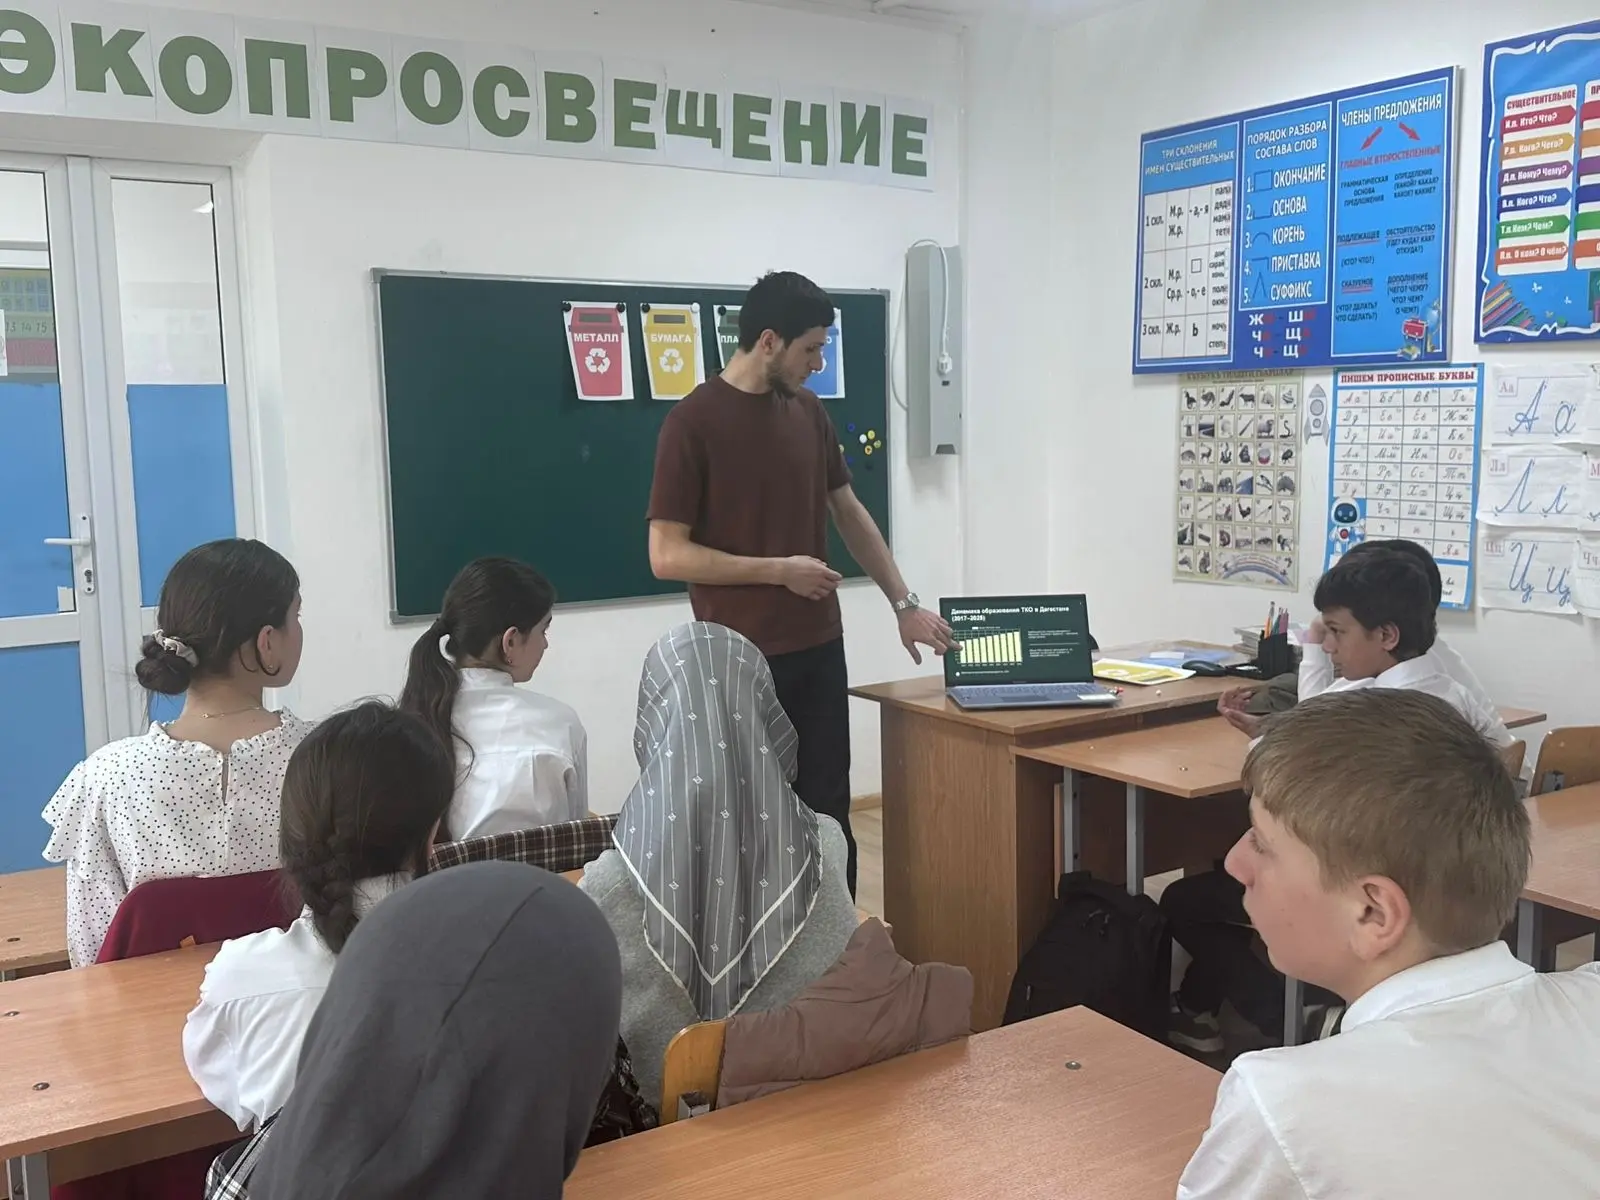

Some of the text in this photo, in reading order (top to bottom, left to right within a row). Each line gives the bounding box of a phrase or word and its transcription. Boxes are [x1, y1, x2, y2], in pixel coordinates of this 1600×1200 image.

[0, 9, 927, 177] ЭКОПРОСВЕЩЕНИЕ
[1507, 89, 1576, 110] СУЩЕСТВИТЕЛЬНОЕ
[1341, 93, 1442, 127] ЧЛЕНЫ ПРЕДЛОЖЕНИЯ
[1520, 115, 1537, 126] Кто?
[1538, 112, 1557, 123] Что?
[1247, 120, 1327, 145] ПОРЯДОК РАЗБОРА
[1162, 140, 1217, 159] ТРИ СКЛОНЕНИЯ
[1255, 138, 1317, 159] СОСТАВА СЛОВ
[1145, 151, 1235, 176] ИМЕН СУЩЕСТВИТЕЛЬНЫХ
[1273, 163, 1326, 189] ОКОНЧАНИЕ
[1273, 195, 1307, 217] ОСНОВА
[1272, 225, 1305, 245] КОРЕНЬ
[1271, 251, 1320, 272] ПРИСТАВКА
[1270, 281, 1313, 301] СУФФИКС
[36, 321, 47, 333] 15
[574, 332, 619, 343] МЕТАЛЛ
[650, 333, 692, 344] БУМАГА
[1341, 371, 1474, 383] ПИШЕМ ПРОПИСНЫЕ БУКВЫ
[951, 608, 981, 616] Динамика
